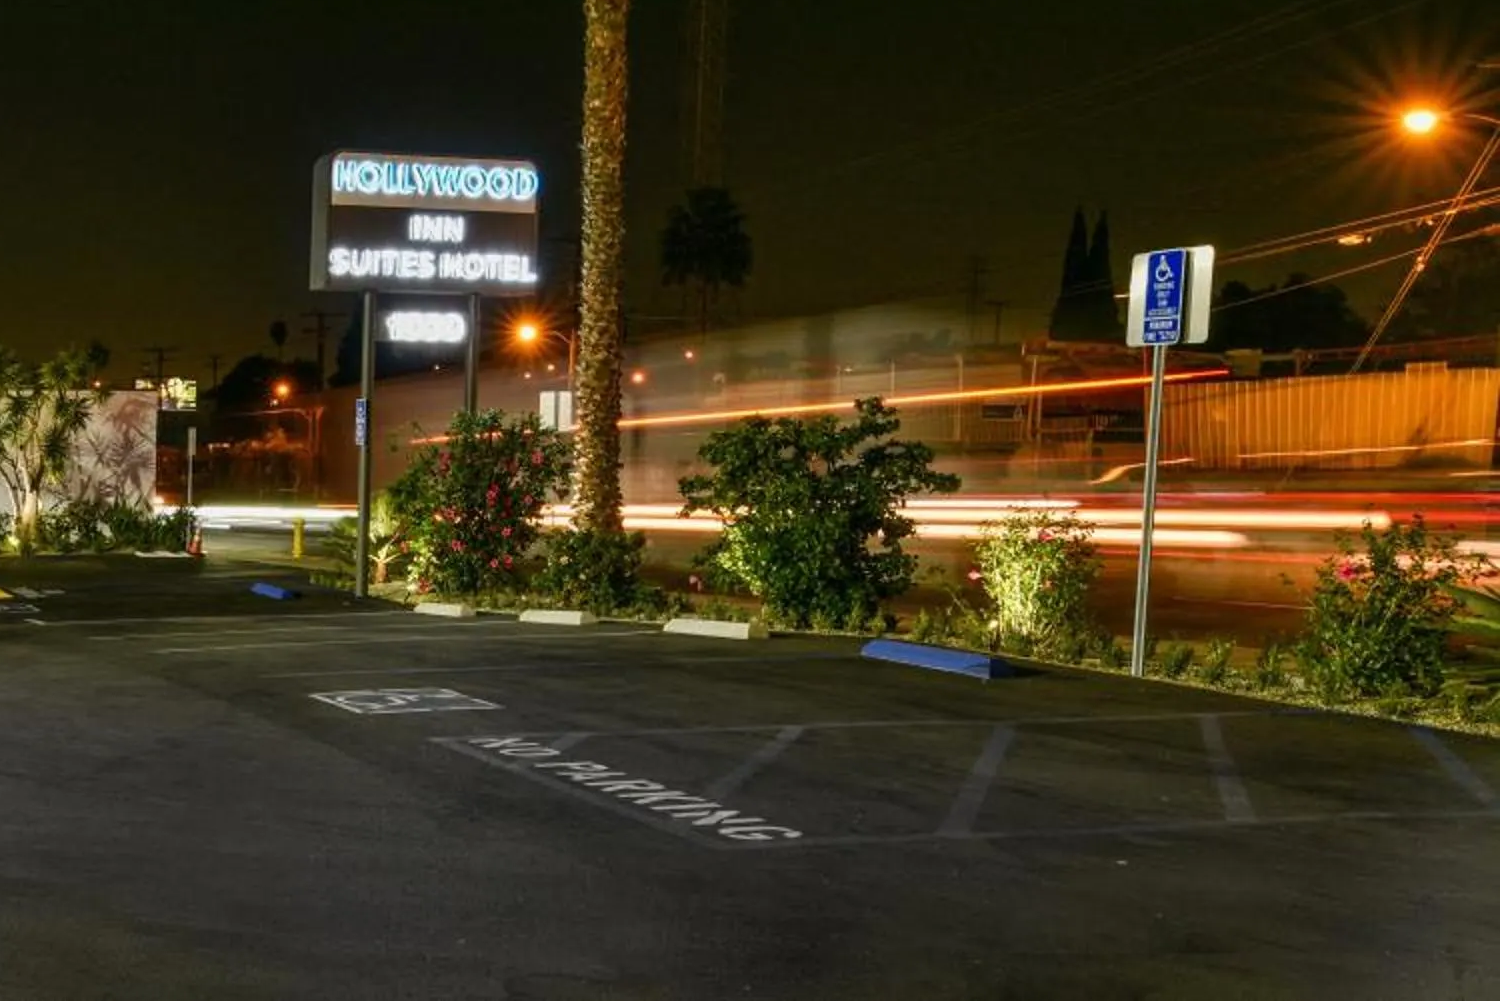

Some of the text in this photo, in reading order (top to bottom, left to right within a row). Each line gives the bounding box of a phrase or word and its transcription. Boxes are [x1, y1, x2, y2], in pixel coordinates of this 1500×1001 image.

[333, 159, 539, 200] HOLLYWOOD
[409, 214, 466, 242] INN
[329, 249, 538, 283] SUITES HOTEL
[468, 736, 803, 841] NO PARKING
